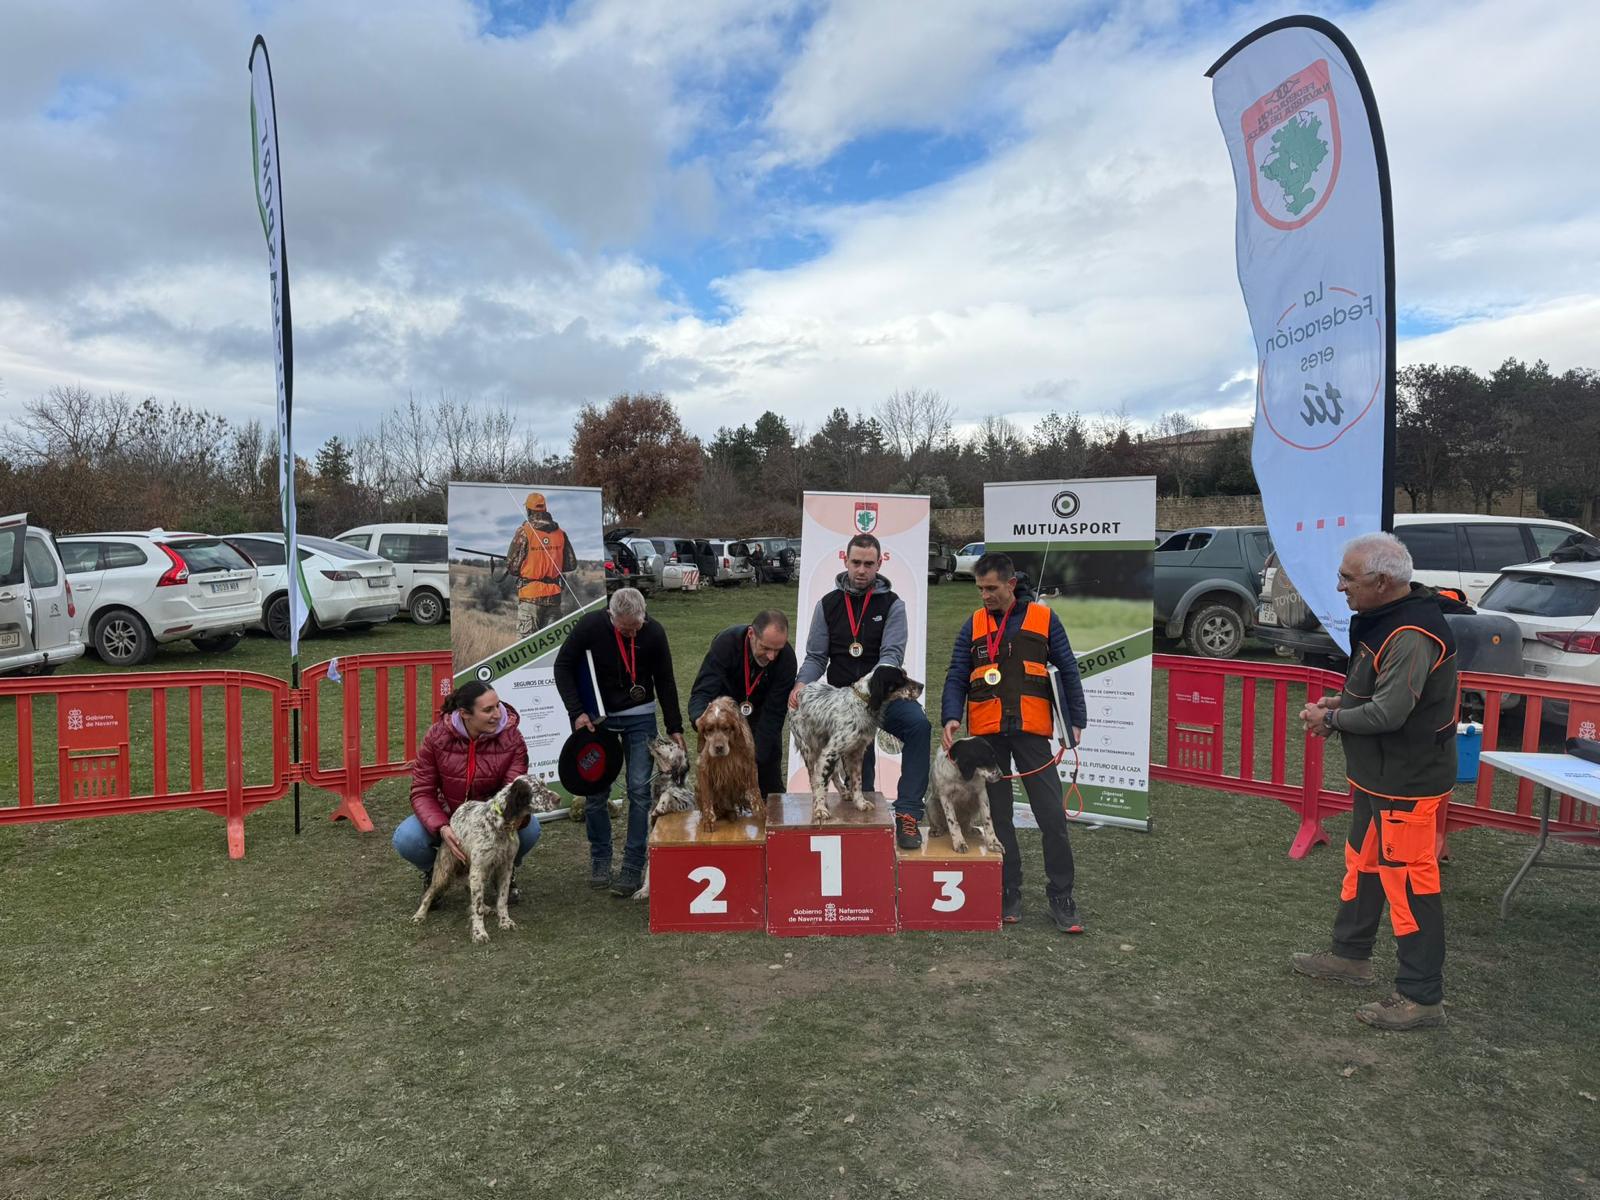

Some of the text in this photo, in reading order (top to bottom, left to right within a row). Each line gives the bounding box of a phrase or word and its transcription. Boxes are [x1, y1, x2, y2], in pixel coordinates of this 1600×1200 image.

[1012, 521, 1121, 536] MUTUASPORT
[1275, 592, 1301, 607] TOYO
[1, 633, 16, 645] HPJ
[495, 619, 580, 672] MUTUASPO
[1077, 646, 1126, 674] SPORT
[513, 680, 537, 688] SEGUROS
[1089, 762, 1111, 770] FUTURO
[810, 835, 843, 897] 1
[687, 865, 728, 914] 2
[931, 870, 966, 912] 3
